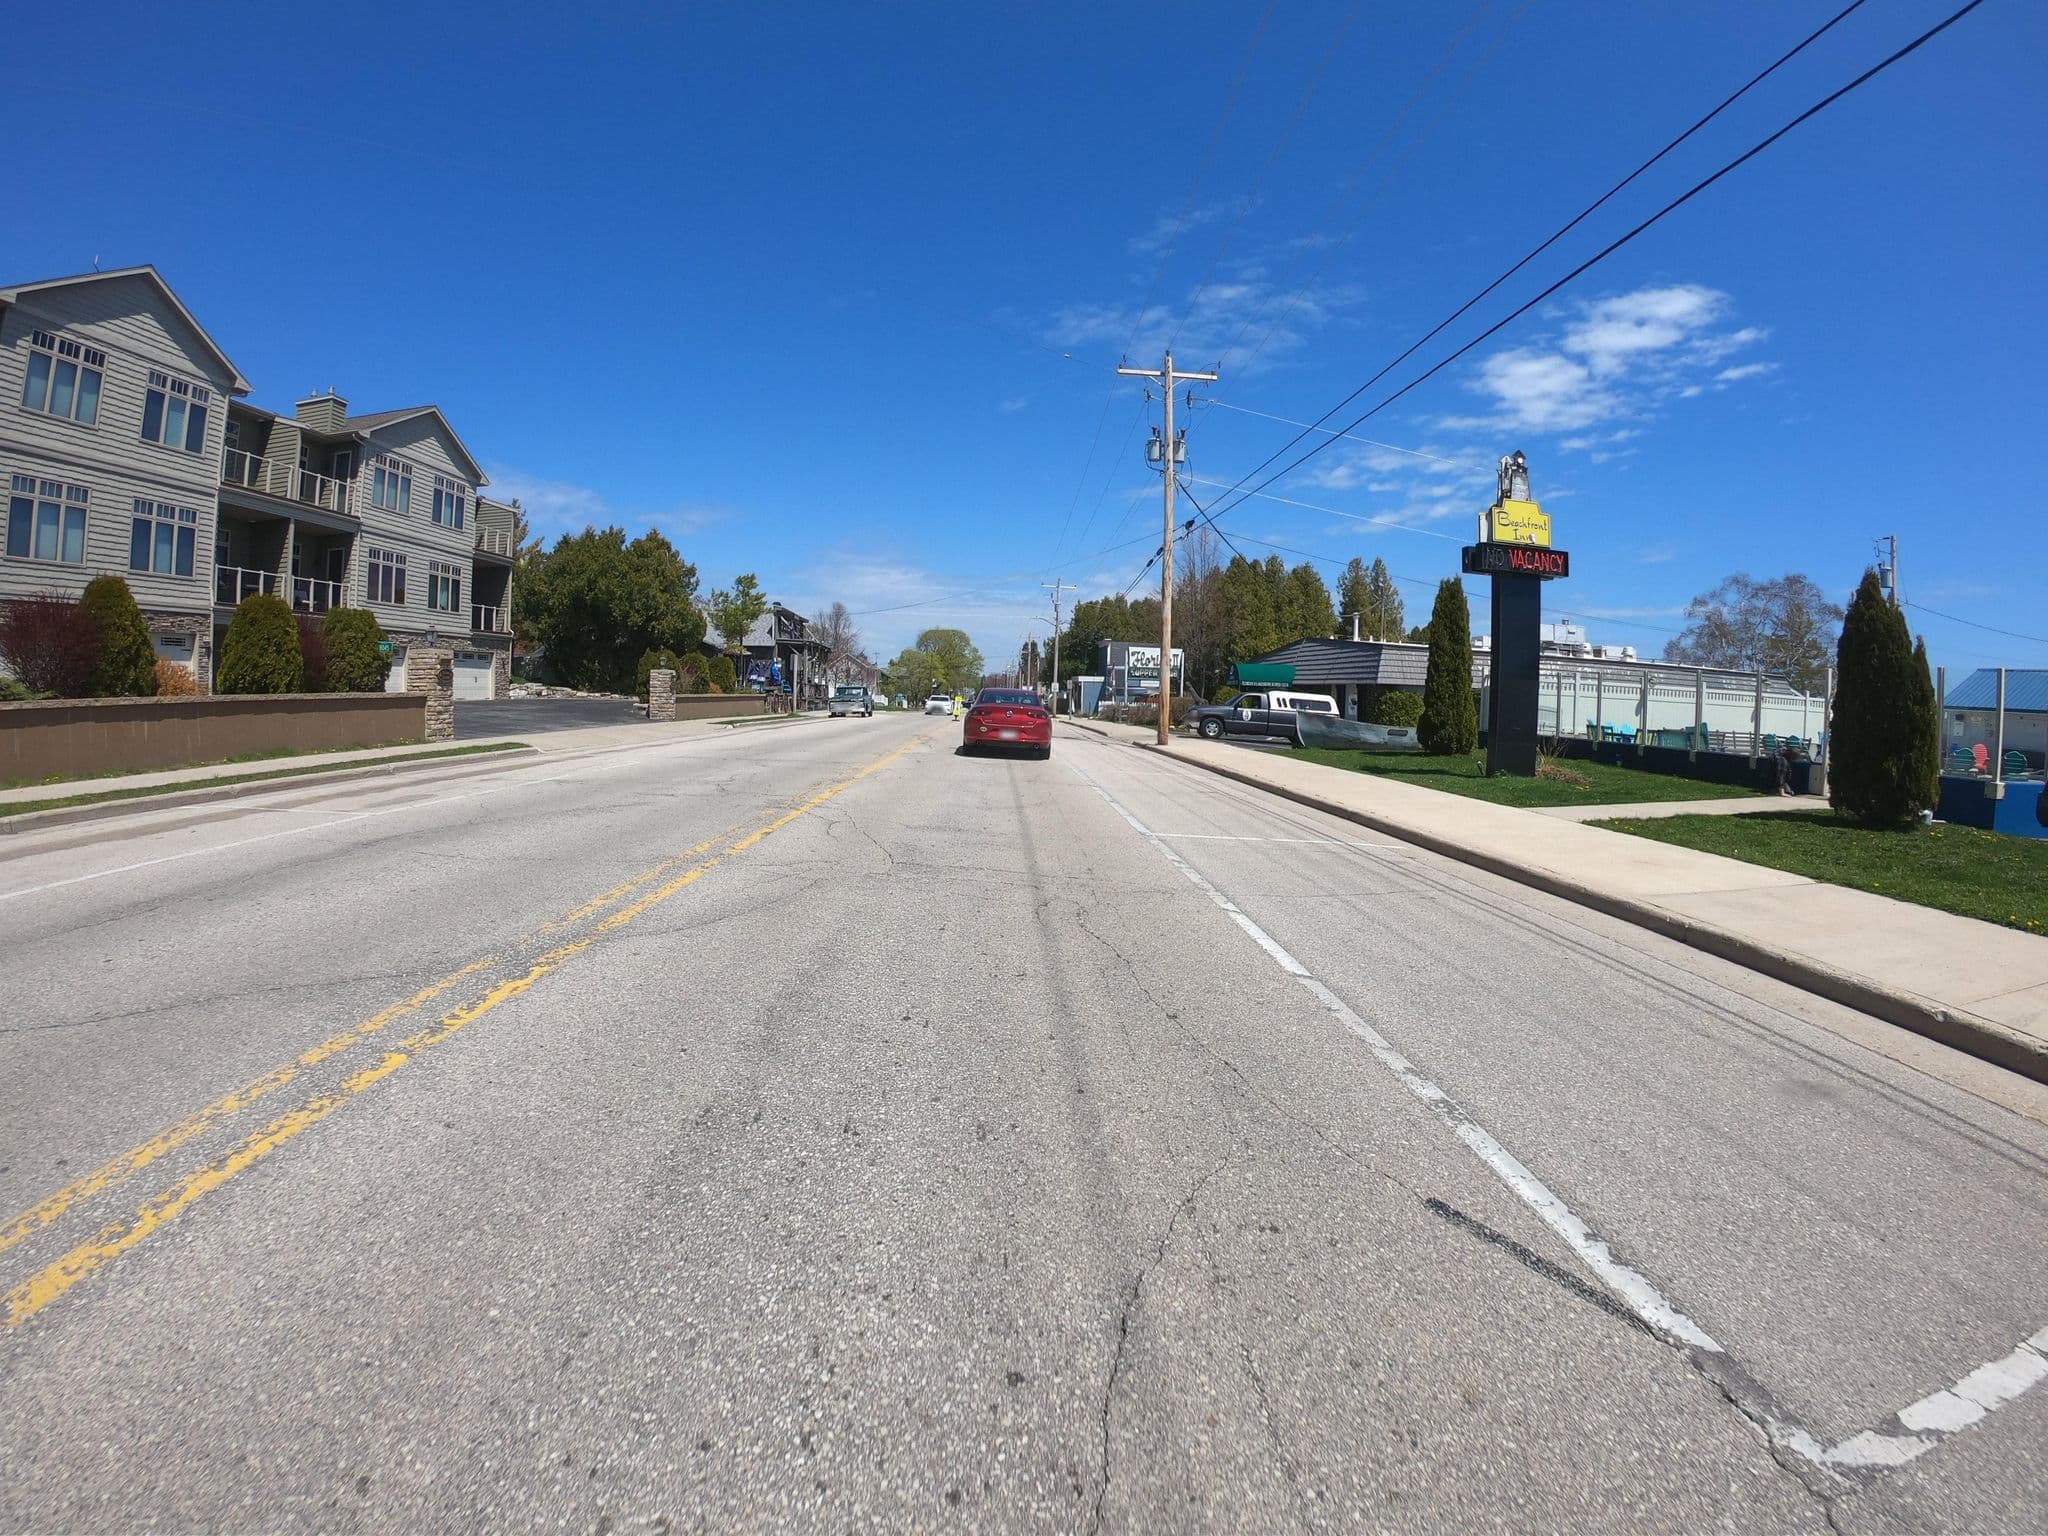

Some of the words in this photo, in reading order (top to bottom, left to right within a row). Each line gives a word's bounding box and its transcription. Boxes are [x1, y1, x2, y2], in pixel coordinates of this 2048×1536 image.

[1496, 511, 1548, 531] Beachfront
[1486, 547, 1504, 567] NO
[1509, 550, 1564, 573] VACANCY
